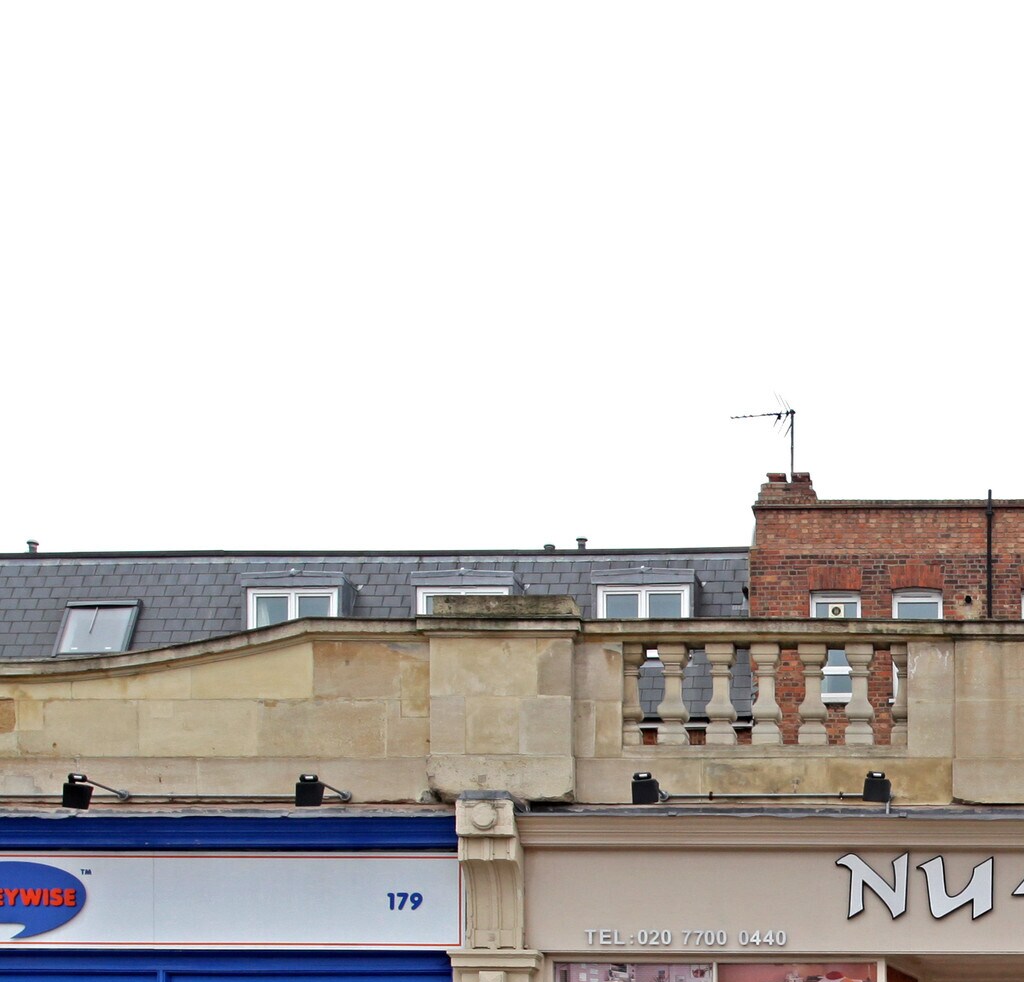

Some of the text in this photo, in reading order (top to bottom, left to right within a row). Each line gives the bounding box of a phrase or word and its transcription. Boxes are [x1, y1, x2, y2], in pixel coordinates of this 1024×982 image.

[387, 892, 423, 911] 179
[681, 930, 727, 946] 7700
[738, 930, 787, 947] 0440
